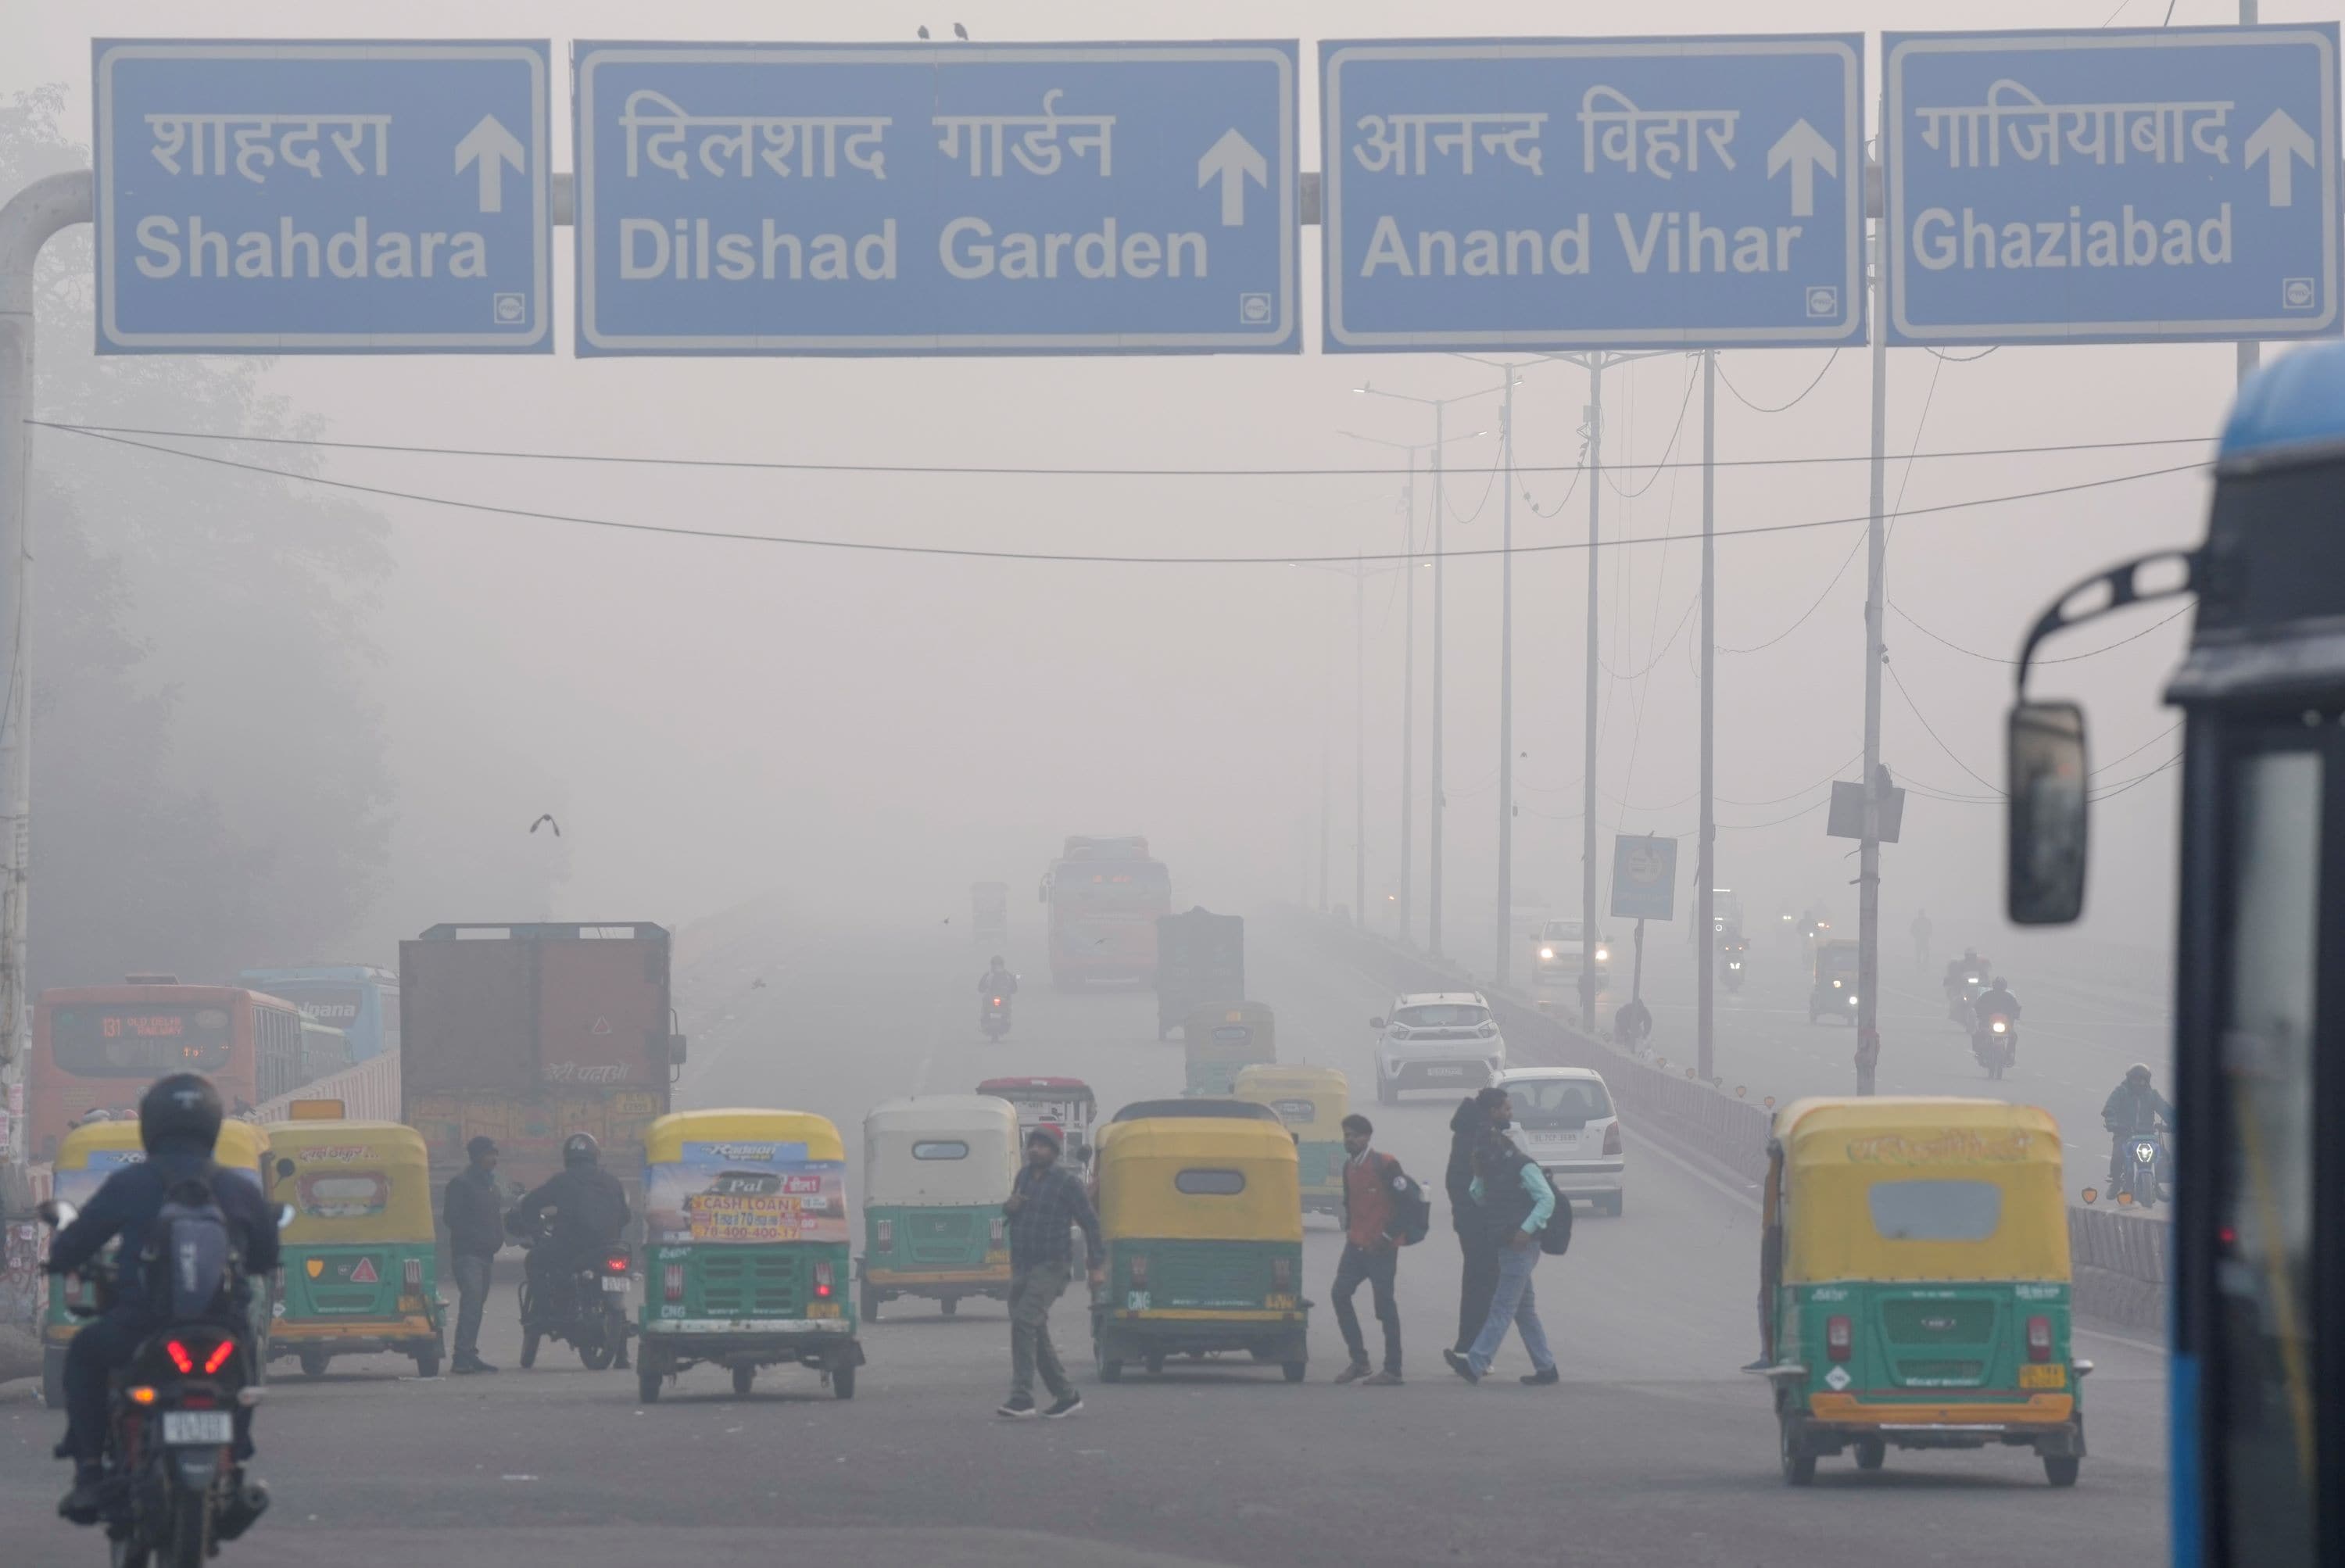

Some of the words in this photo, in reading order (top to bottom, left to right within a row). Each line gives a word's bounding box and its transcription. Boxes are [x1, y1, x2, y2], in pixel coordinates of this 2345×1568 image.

[145, 113, 392, 184] शाहदरा
[618, 88, 893, 181] दिलशाद
[932, 88, 1116, 178] गार्डन
[1353, 113, 1548, 176] आनन्द
[1576, 84, 1740, 181] विहार
[1915, 78, 2235, 168] गाजियाबाद
[134, 215, 488, 279] Shahdara
[620, 218, 897, 281] Dilshad
[938, 217, 1208, 280] Garden
[1359, 213, 1590, 277] Anand
[1613, 211, 1803, 274] Vihar
[1912, 202, 2232, 271] Ghaziabad
[704, 1197, 742, 1210] CASH
[747, 1198, 789, 1211] LOAN
[729, 1179, 764, 1192] Pal
[661, 1305, 686, 1319] CNG
